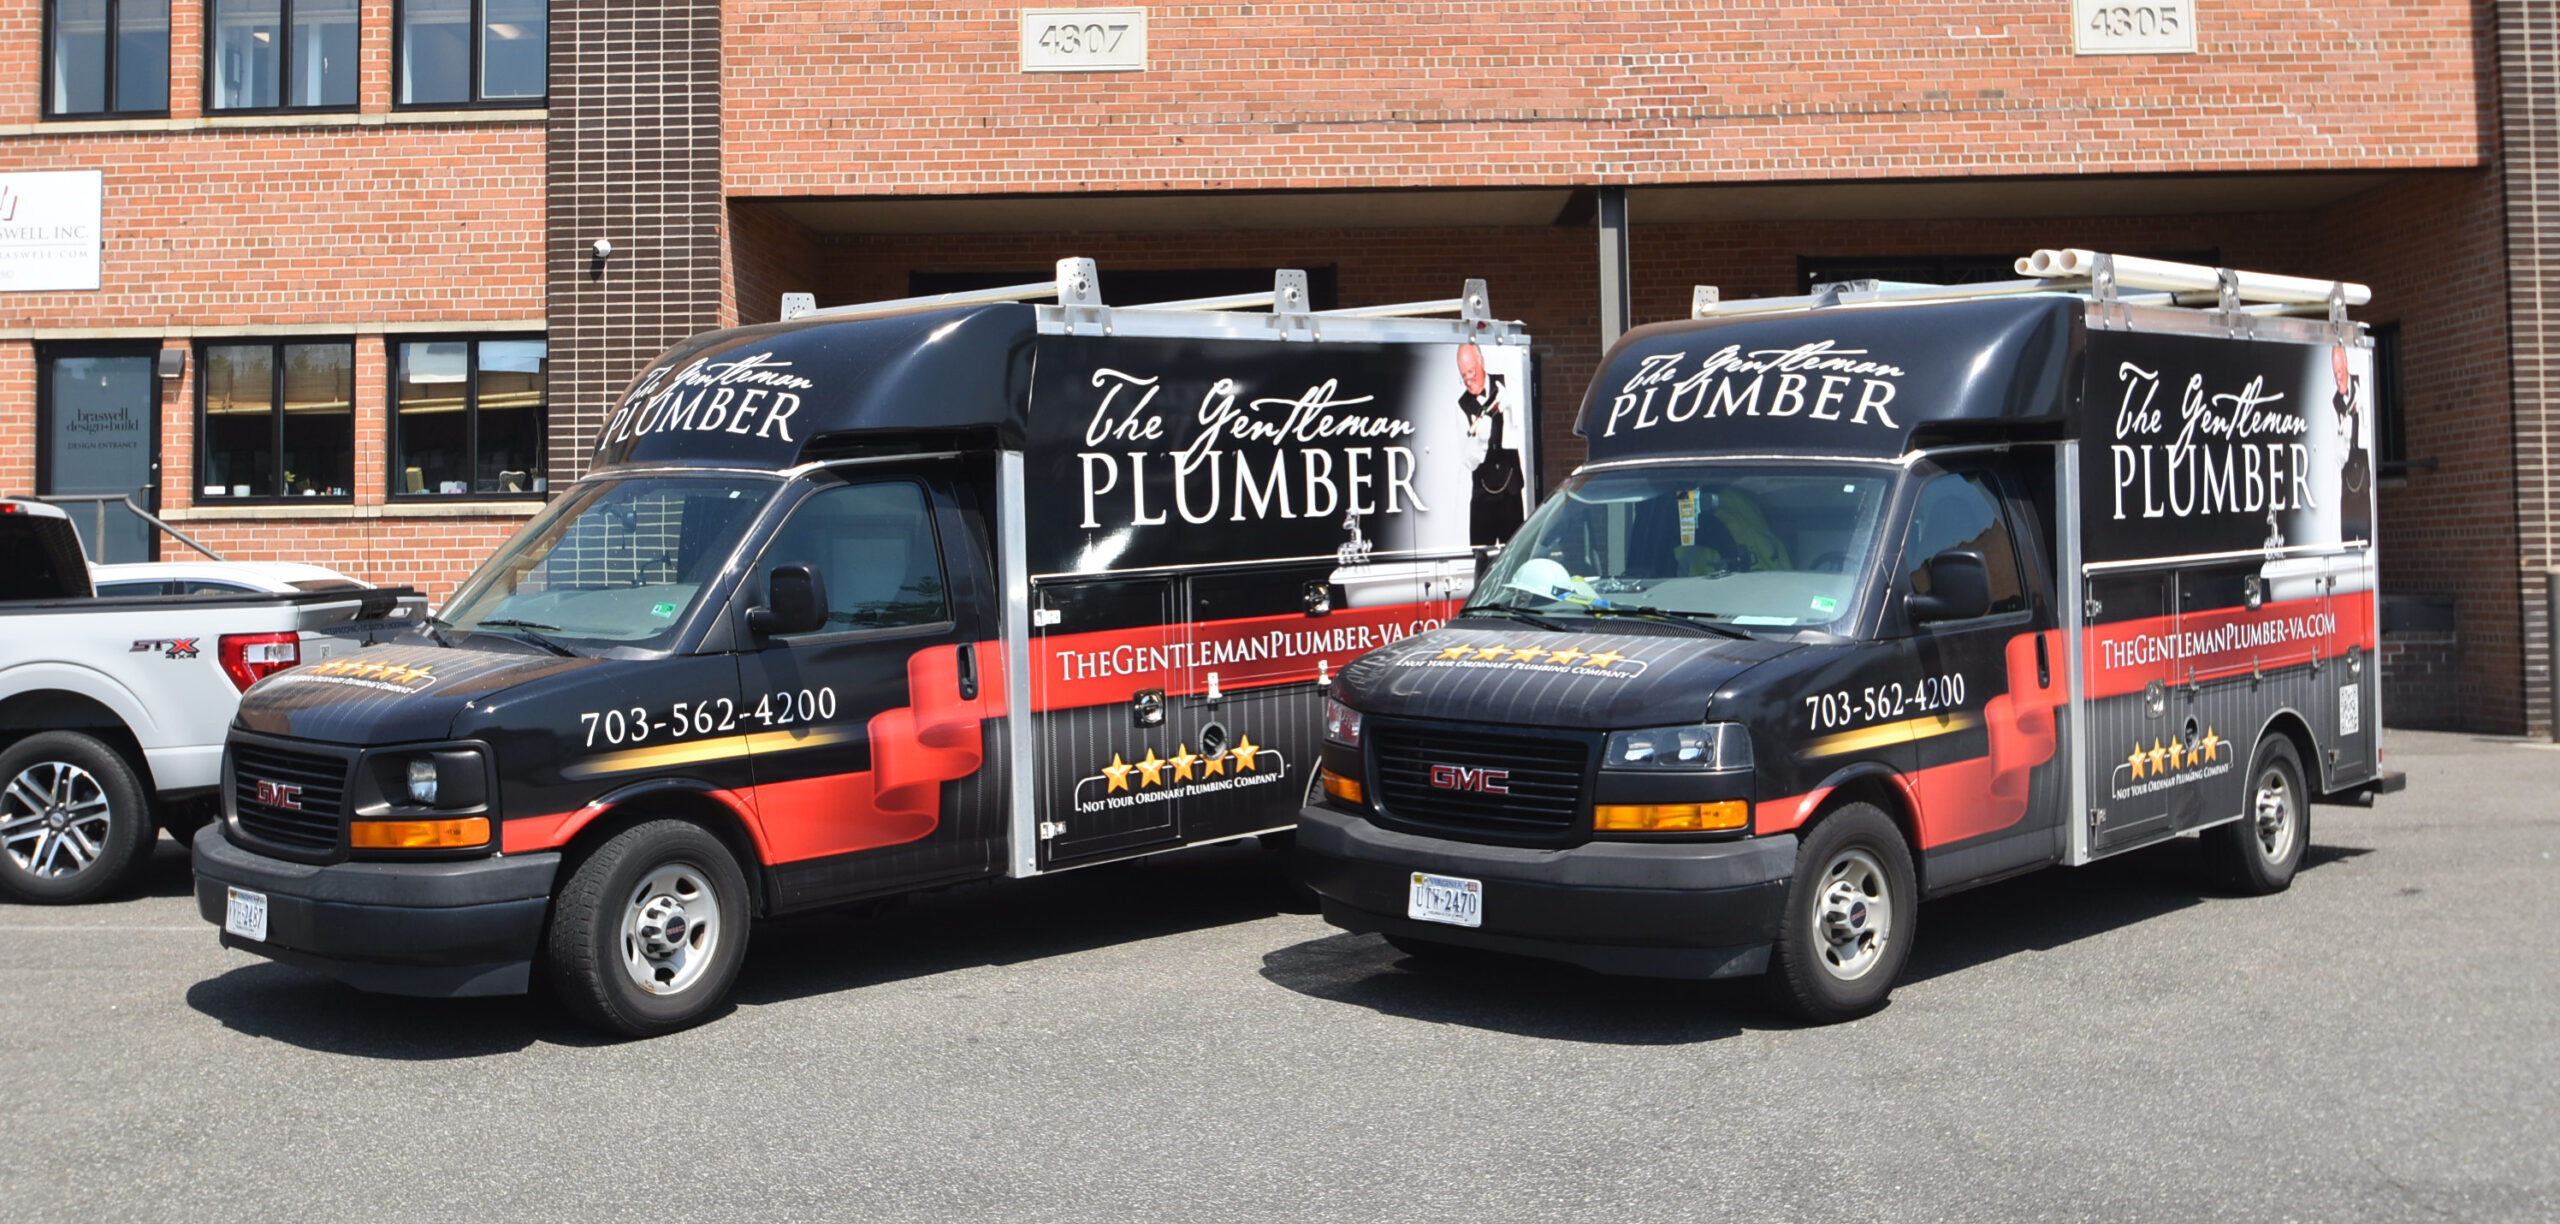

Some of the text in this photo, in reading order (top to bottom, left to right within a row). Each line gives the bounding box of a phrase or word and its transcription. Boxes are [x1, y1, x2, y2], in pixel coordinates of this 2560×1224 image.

[1038, 24, 1129, 54] 4307
[2090, 6, 2178, 37] 4305
[624, 352, 814, 409] The Gentleman
[1623, 340, 1905, 396] The Gentleman
[77, 407, 129, 422] braswell
[599, 387, 800, 451] PLUMBER
[1085, 368, 1416, 476] The Gentleman
[1603, 374, 1900, 438] PLUMBER
[2116, 361, 2309, 470] The Gentleman
[1077, 446, 1432, 529] PLUMBER
[2111, 443, 2318, 520] PLUMBER
[129, 637, 200, 654] STX
[1057, 618, 1446, 681] THEGENTLEMANPLUMBER-VACO
[1455, 660, 1514, 670] ORDINARY
[1512, 662, 1570, 673] PLUMBING
[1571, 666, 1630, 679] COMPANY
[581, 686, 837, 748] 703-562-4200
[1805, 672, 1966, 731] 703-562-4200
[256, 780, 302, 811] GMC
[1082, 772, 1279, 814] NOT YOUR ORDINARY PLUMBING COMPANY
[1431, 764, 1510, 795] GMC
[2116, 787, 2131, 801] NOT
[2147, 776, 2176, 793] ORDINAR
[2203, 762, 2230, 779] COMPANY
